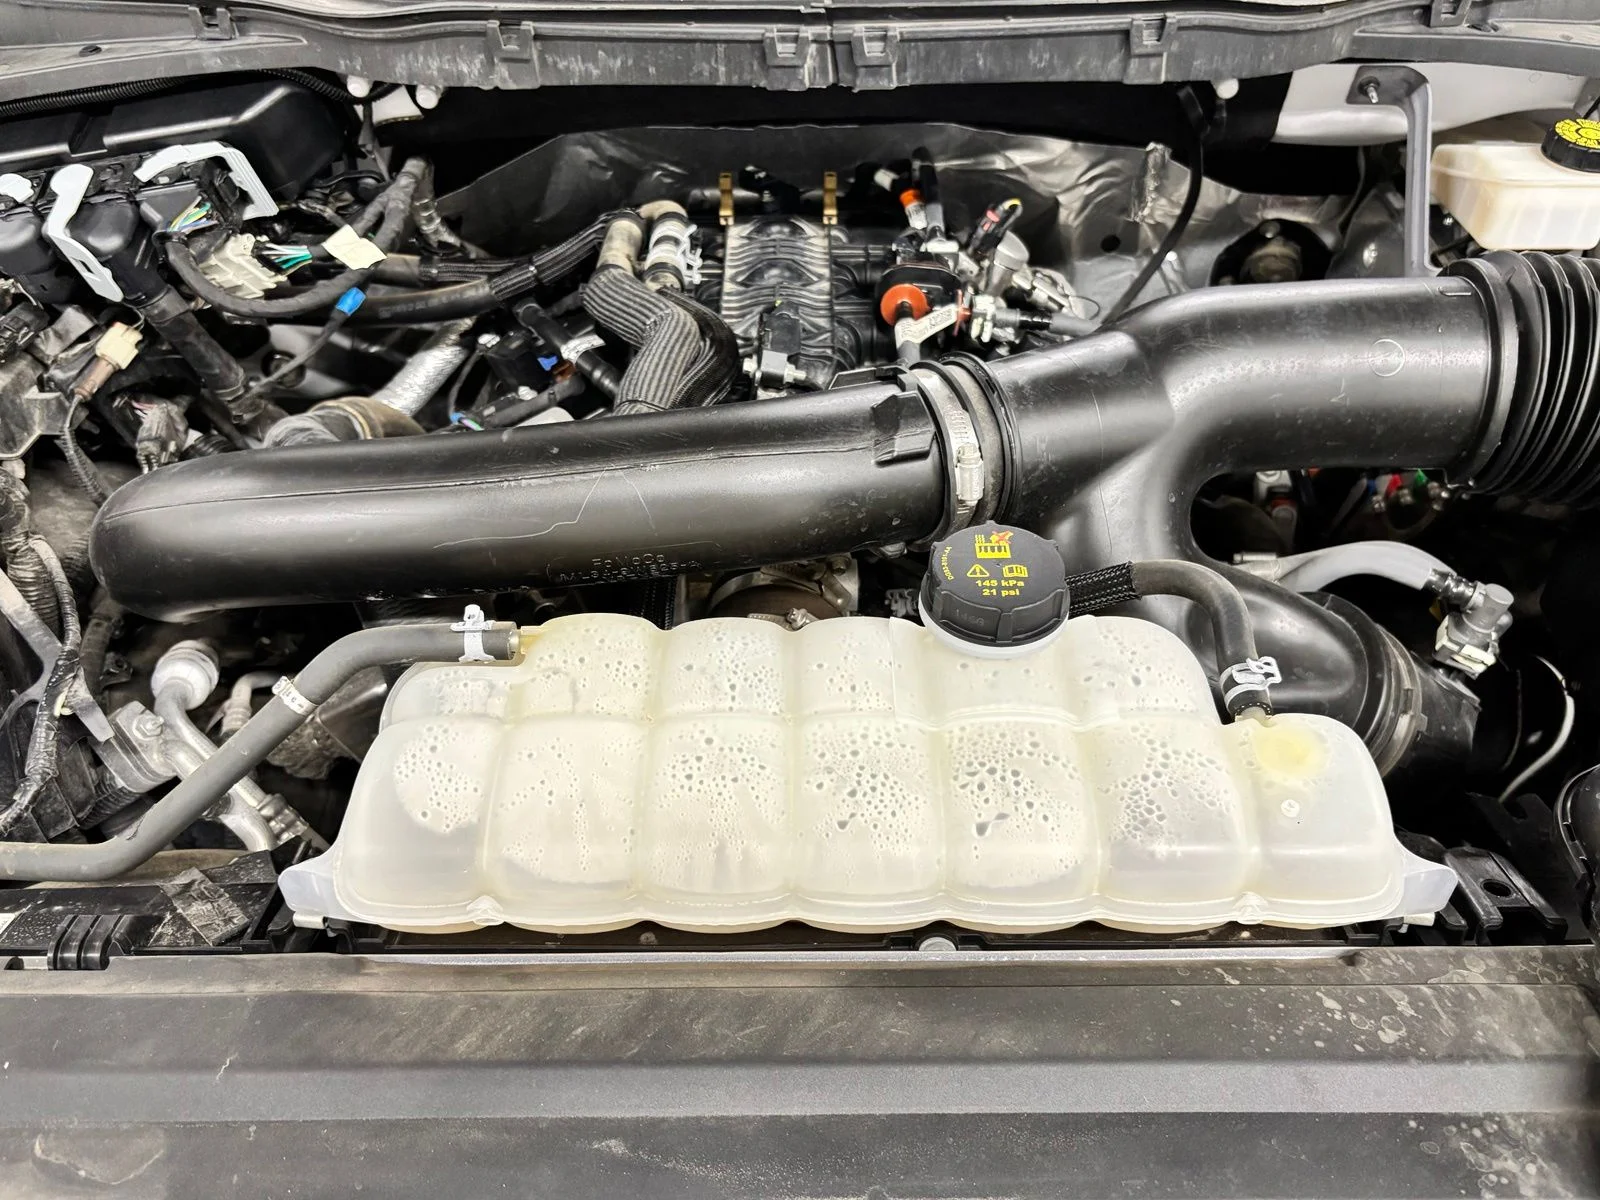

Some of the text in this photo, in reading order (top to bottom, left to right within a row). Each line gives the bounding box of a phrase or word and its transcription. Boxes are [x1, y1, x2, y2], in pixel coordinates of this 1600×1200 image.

[975, 579, 1025, 587] 145 kPa
[982, 588, 1020, 597] 21 psi
